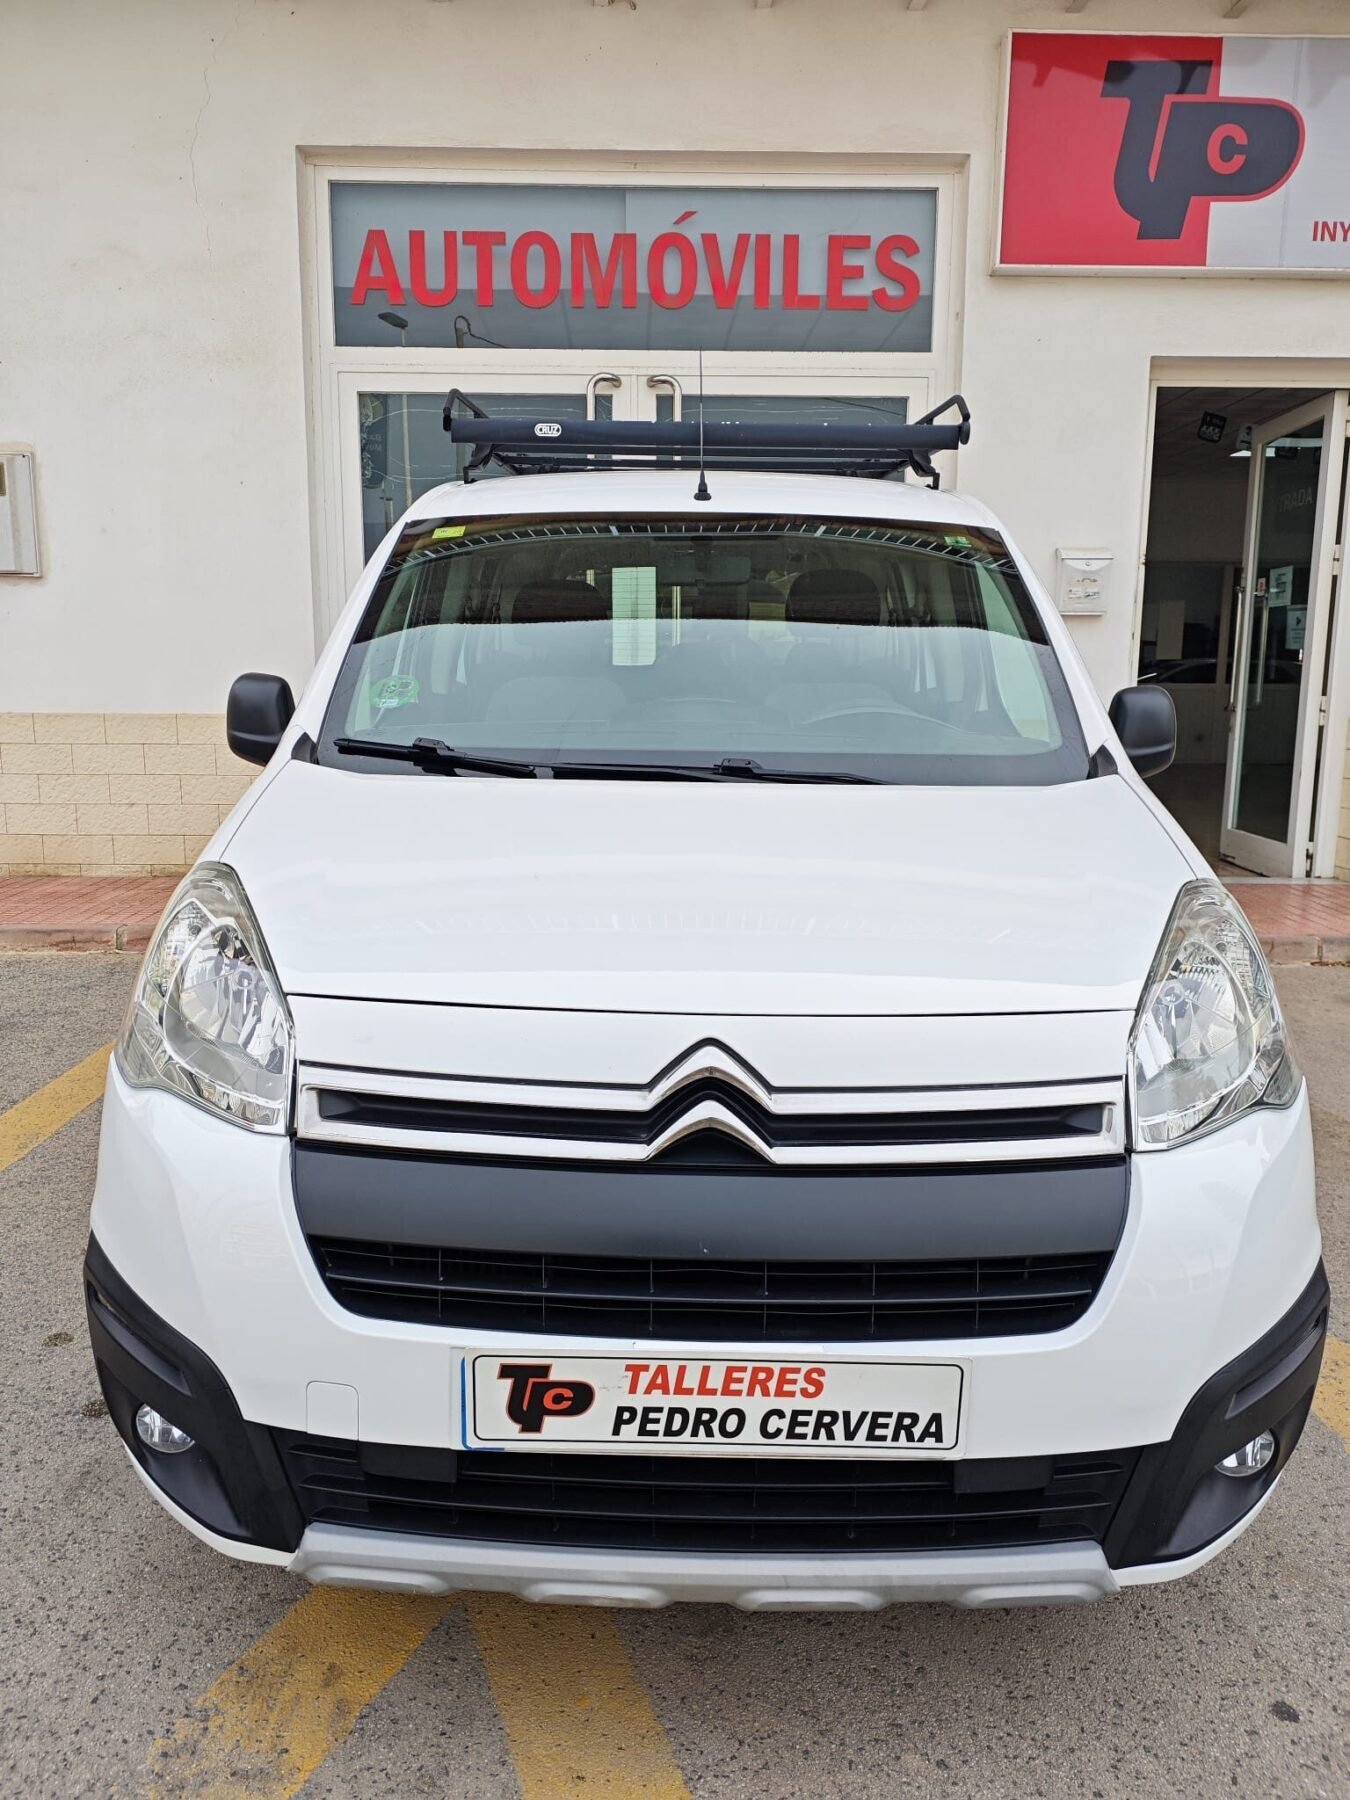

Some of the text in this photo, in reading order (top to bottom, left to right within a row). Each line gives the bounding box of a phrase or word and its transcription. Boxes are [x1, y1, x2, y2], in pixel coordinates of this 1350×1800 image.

[350, 210, 922, 312] AUTOMÓVILES
[536, 425, 560, 434] CRUZ
[623, 1364, 827, 1399] TALLERES
[611, 1405, 945, 1443] PEDRO CERVERA
